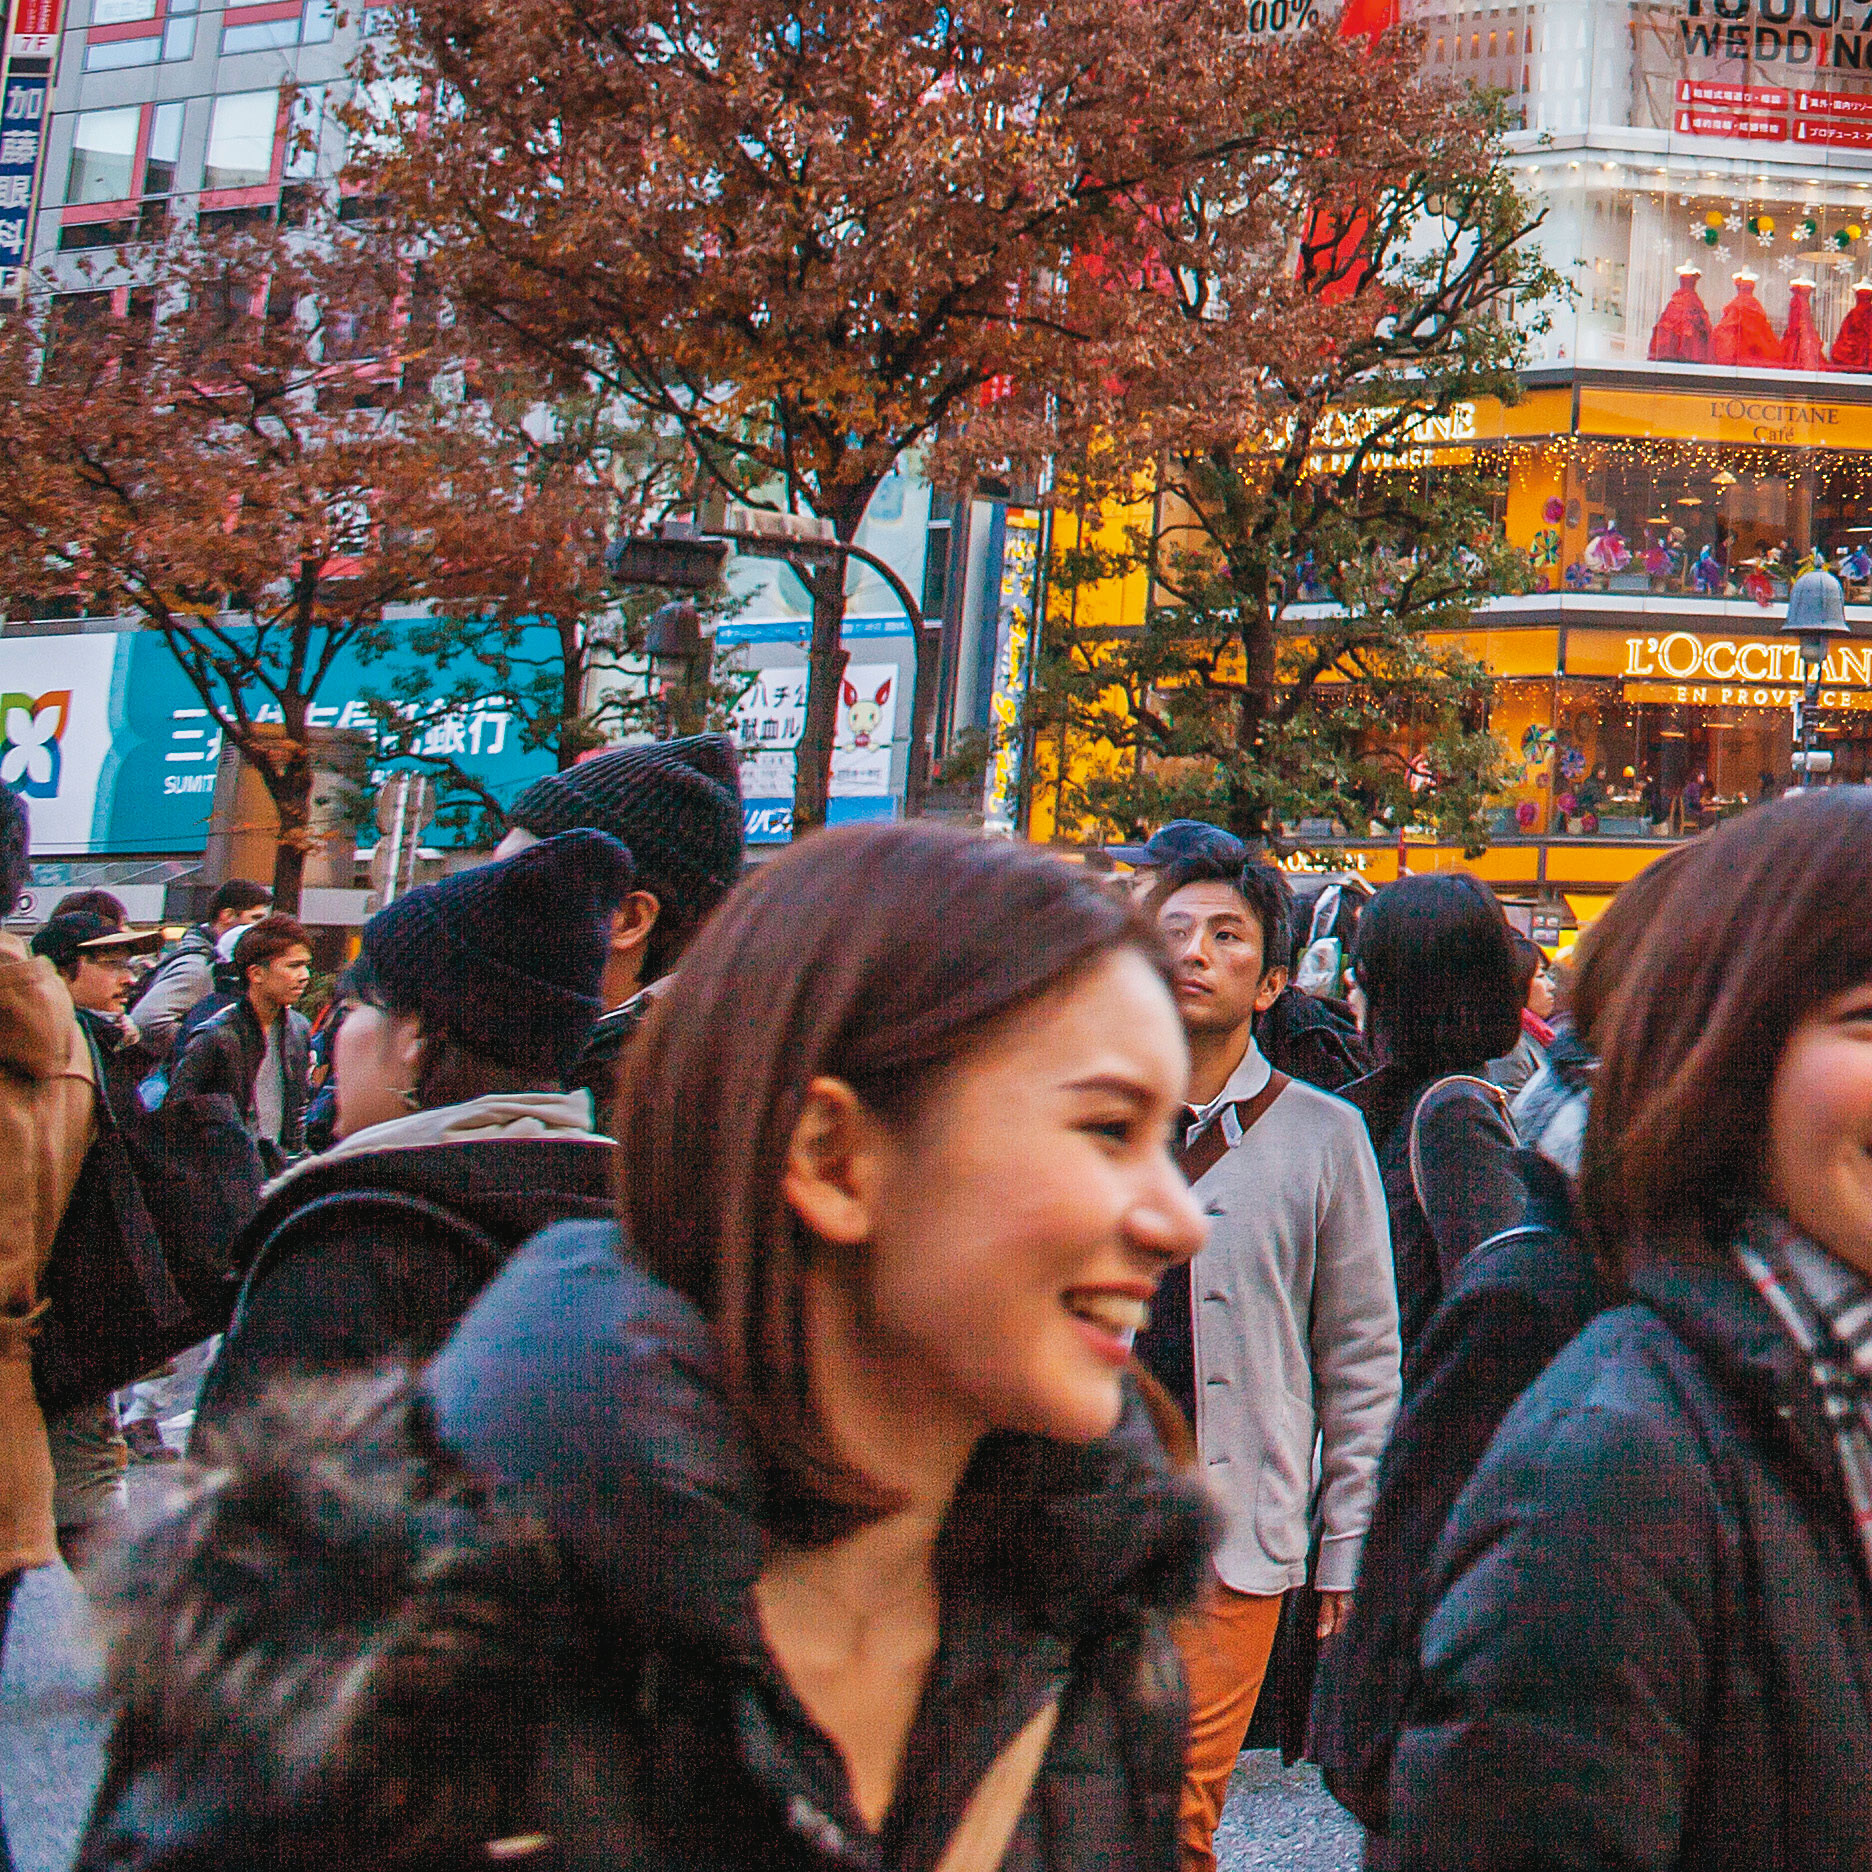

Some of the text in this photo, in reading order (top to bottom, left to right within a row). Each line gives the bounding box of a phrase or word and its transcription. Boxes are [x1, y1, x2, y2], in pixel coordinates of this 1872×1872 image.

[19, 36, 50, 52] 7F
[1709, 397, 1840, 427] L'OCCITANE
[1752, 425, 1797, 444] Café
[1677, 687, 1705, 704] EN
